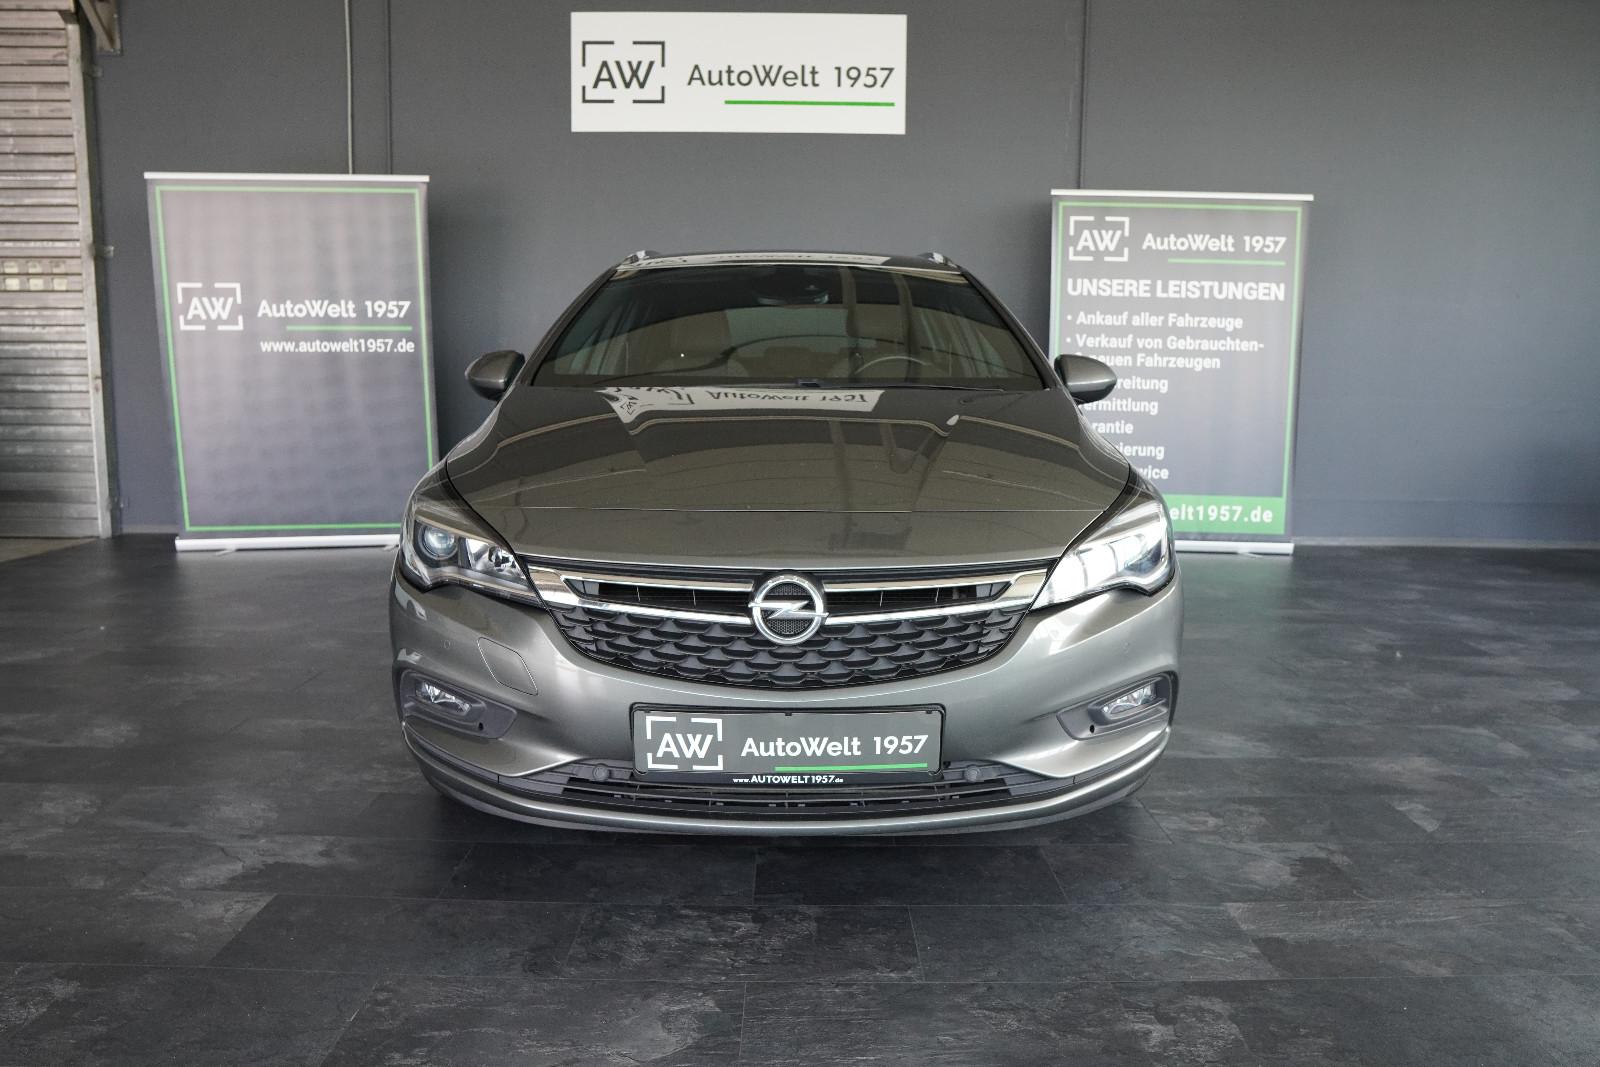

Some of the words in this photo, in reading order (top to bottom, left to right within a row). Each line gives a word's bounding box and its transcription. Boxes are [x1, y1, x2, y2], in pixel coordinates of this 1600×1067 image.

[592, 60, 655, 89] AW
[687, 64, 820, 87] AutoWelt
[834, 66, 895, 88] 1957
[1075, 230, 1122, 252] AW
[1142, 233, 1235, 252] AutoWelt
[1243, 236, 1287, 254] 1957
[1067, 278, 1152, 297] UNSERE
[1156, 280, 1285, 301] LEISTUNGEN
[186, 297, 234, 320] AW
[257, 299, 356, 318] AutoWelt
[365, 300, 411, 318] 1957
[1075, 311, 1129, 326] Ankauf
[1132, 312, 1164, 327] aller
[1168, 313, 1243, 332] Fahrzeuge
[260, 338, 415, 353] www.autowelt1957.de
[1075, 334, 1133, 349] Verkauf
[1136, 337, 1162, 350] von
[1167, 336, 1265, 352] Gebrauchten-
[1136, 353, 1221, 371] Fahrzeugen
[1117, 375, 1169, 393] reitung
[1079, 397, 1159, 415] ermittlung
[1092, 420, 1134, 434] rantie
[656, 732, 714, 759] AW
[741, 736, 862, 757] AutoWelt
[873, 734, 929, 755] 1957
